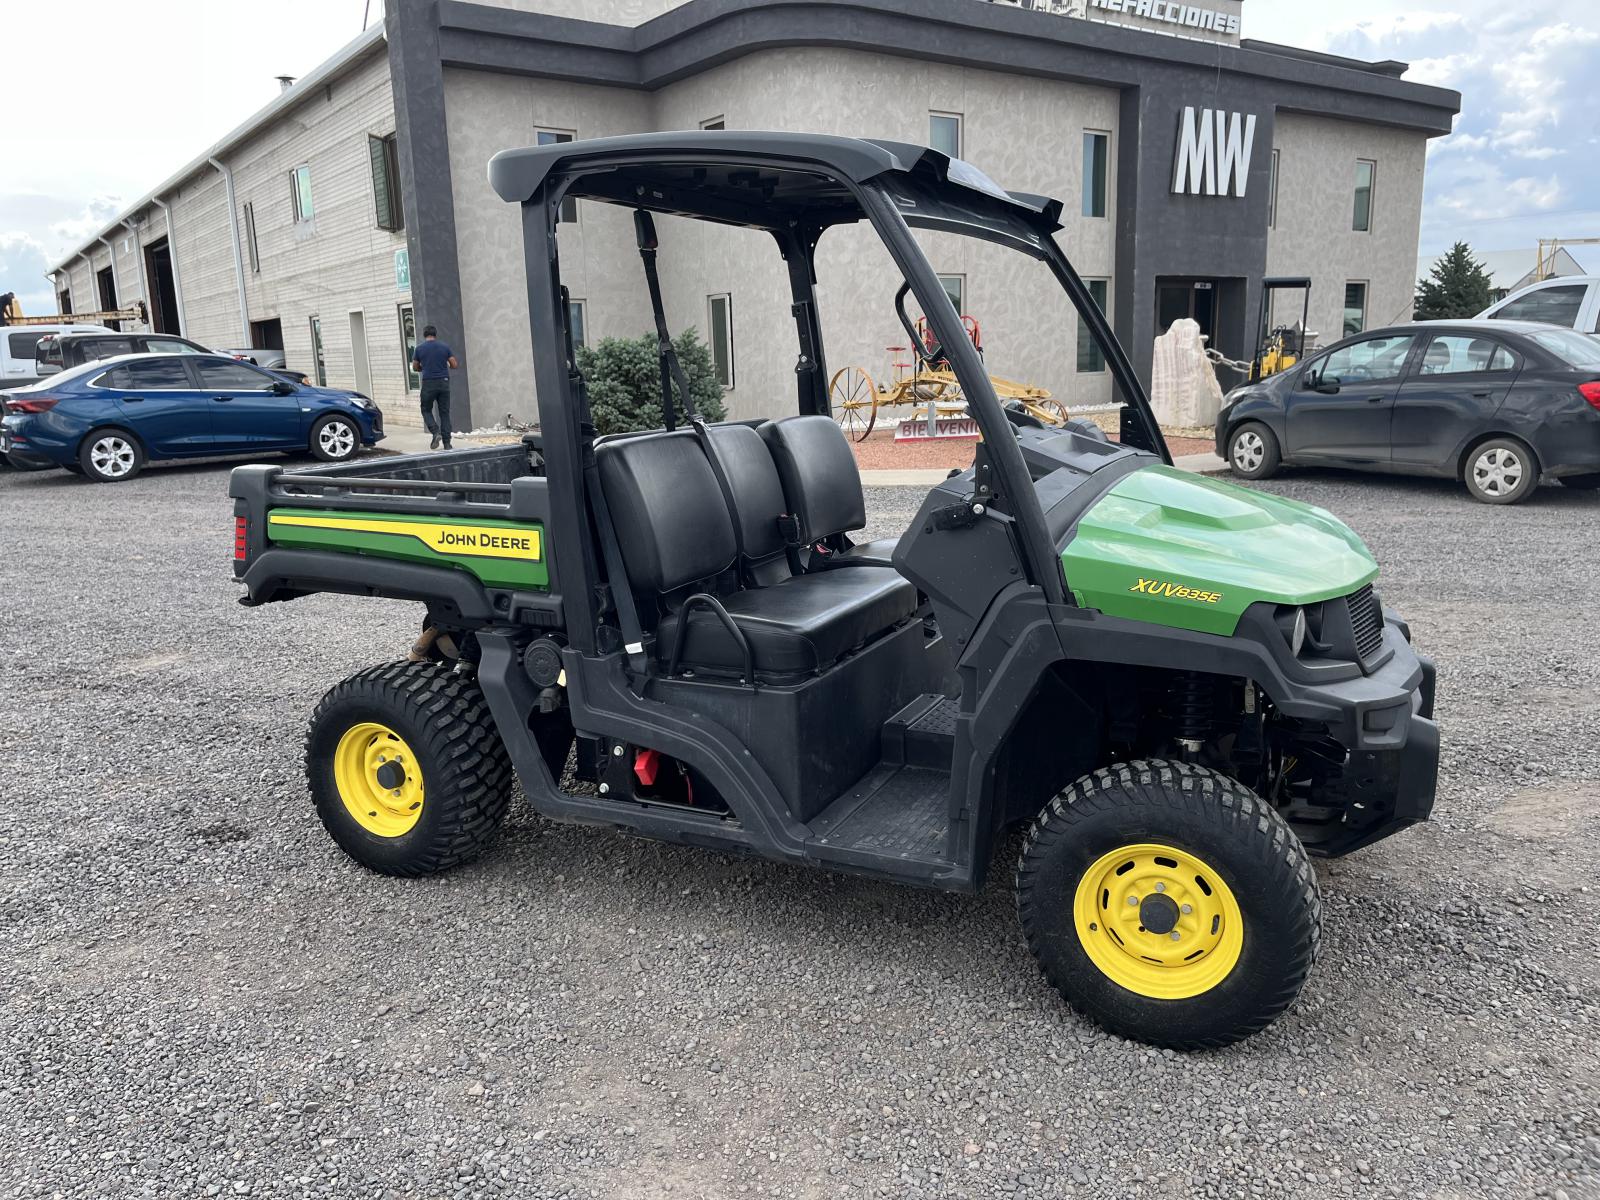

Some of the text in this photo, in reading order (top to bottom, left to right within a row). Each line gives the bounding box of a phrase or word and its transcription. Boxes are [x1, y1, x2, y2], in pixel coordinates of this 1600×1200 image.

[1172, 106, 1256, 197] MW
[438, 531, 530, 550] JOHN DEERE
[1129, 578, 1223, 603] XUV835E
